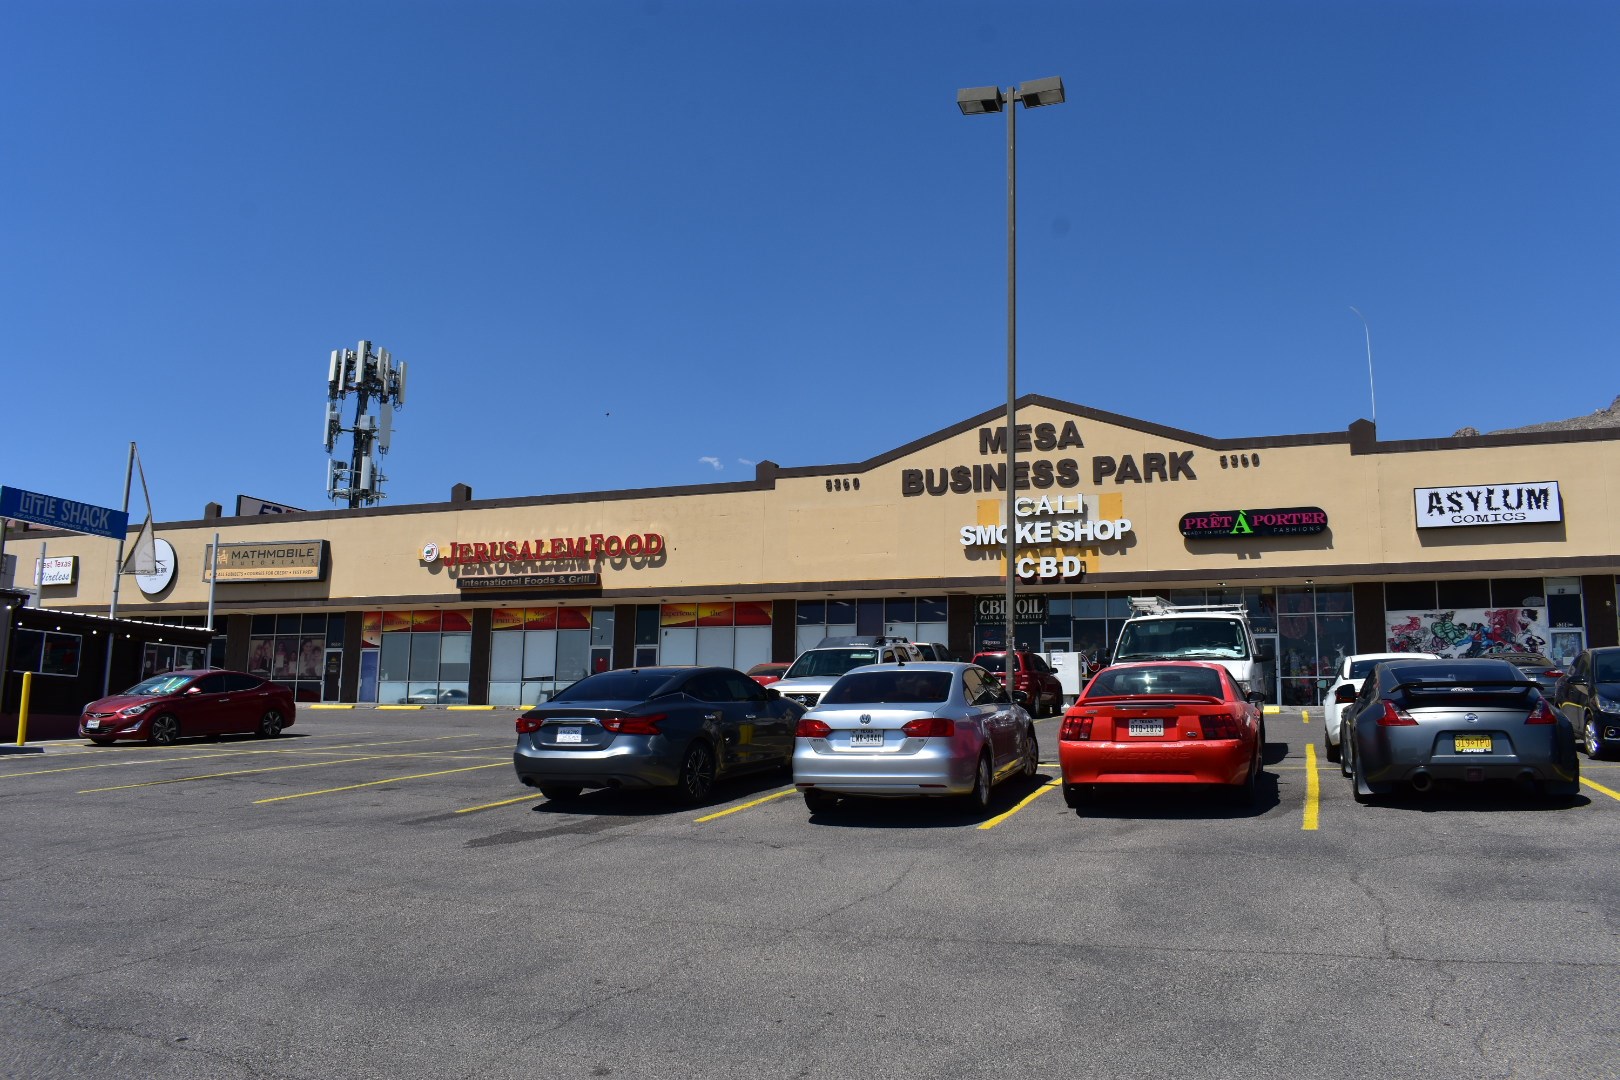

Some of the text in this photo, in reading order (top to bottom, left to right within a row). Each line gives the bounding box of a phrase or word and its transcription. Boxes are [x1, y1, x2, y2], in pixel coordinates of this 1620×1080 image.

[979, 421, 1084, 455] MESA
[1220, 453, 1260, 469] 5360
[826, 477, 860, 492] 5360
[902, 451, 1197, 496] BUSINESS PARK
[1015, 493, 1083, 517] CALI
[1427, 487, 1550, 516] ASYLUM
[61, 500, 111, 530] SHACK
[1184, 509, 1326, 534] PRÊT À PORTER
[1451, 512, 1527, 524] COMICS
[960, 518, 1132, 546] SMOKE SHOP
[1273, 525, 1321, 533] FASHIONS
[231, 548, 315, 560] MATHMOBILE
[444, 533, 663, 567] JERUSALEM FOOD
[55, 560, 72, 568] Texas
[1017, 556, 1081, 578] CBD
[461, 574, 590, 588] International Foods & Grill
[1016, 599, 1043, 615] OIL
